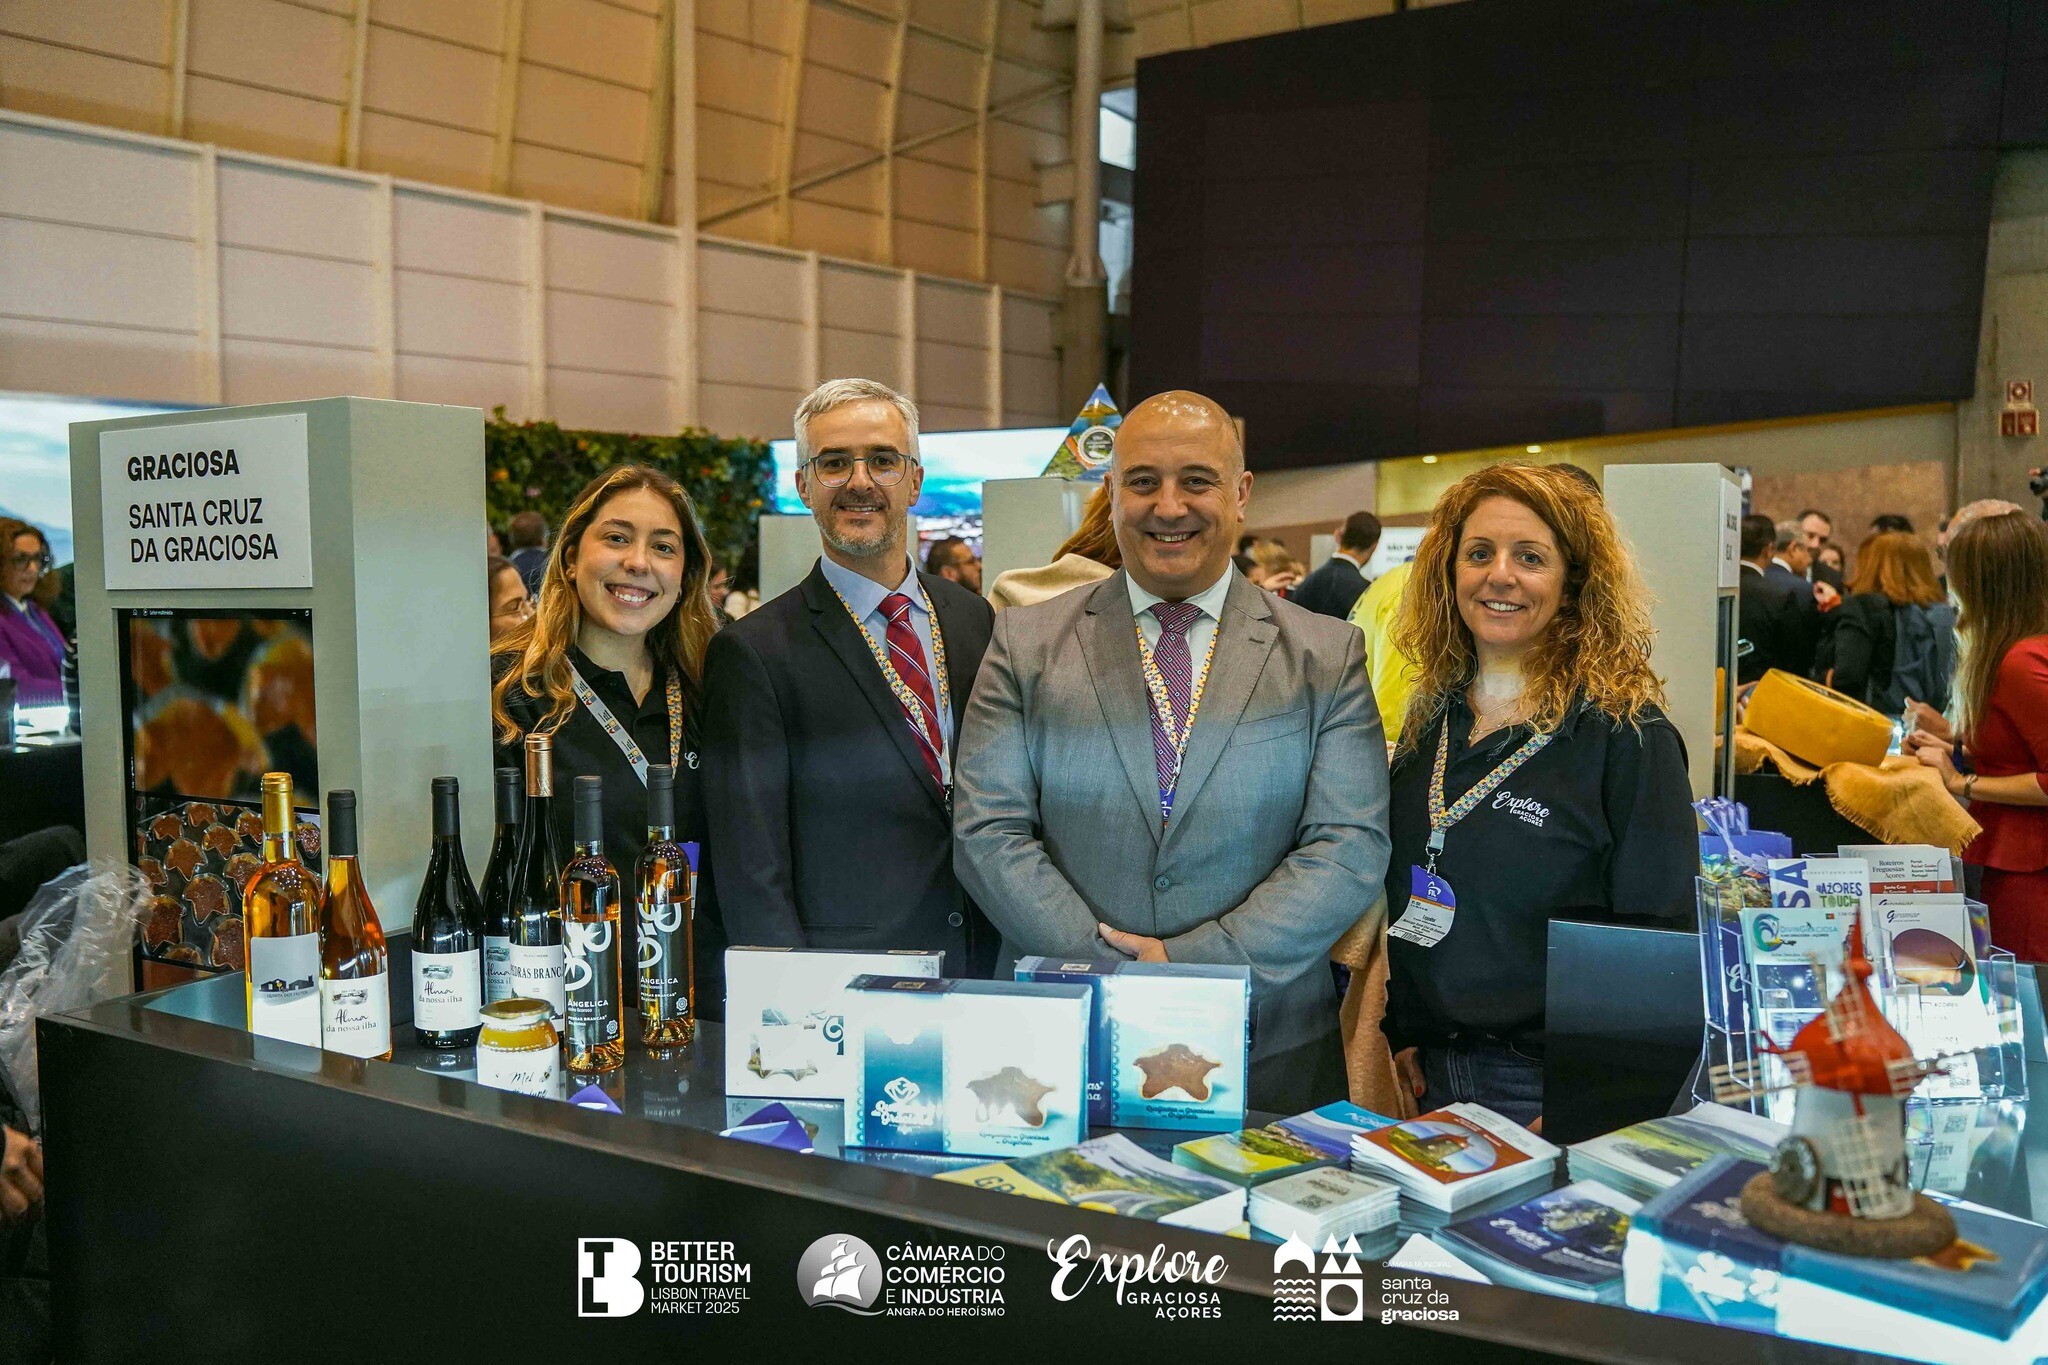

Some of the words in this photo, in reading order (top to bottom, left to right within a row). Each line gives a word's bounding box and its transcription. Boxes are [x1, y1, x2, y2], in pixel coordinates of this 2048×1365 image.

[127, 449, 240, 481] GRACIOSA
[129, 501, 197, 529] SANTA
[203, 498, 263, 526] CRUZ
[131, 538, 159, 563] DA
[164, 533, 279, 562] GRACIOSA
[1492, 791, 1550, 818] Explore
[1512, 809, 1543, 824] GRACIOSA
[1519, 815, 1543, 828] AÇORES
[424, 981, 453, 996] Alma
[425, 996, 445, 1004] nossa
[334, 1008, 369, 1025] Alma
[326, 1025, 336, 1033] da
[337, 1025, 360, 1033] nossa
[361, 1021, 377, 1032] ilha
